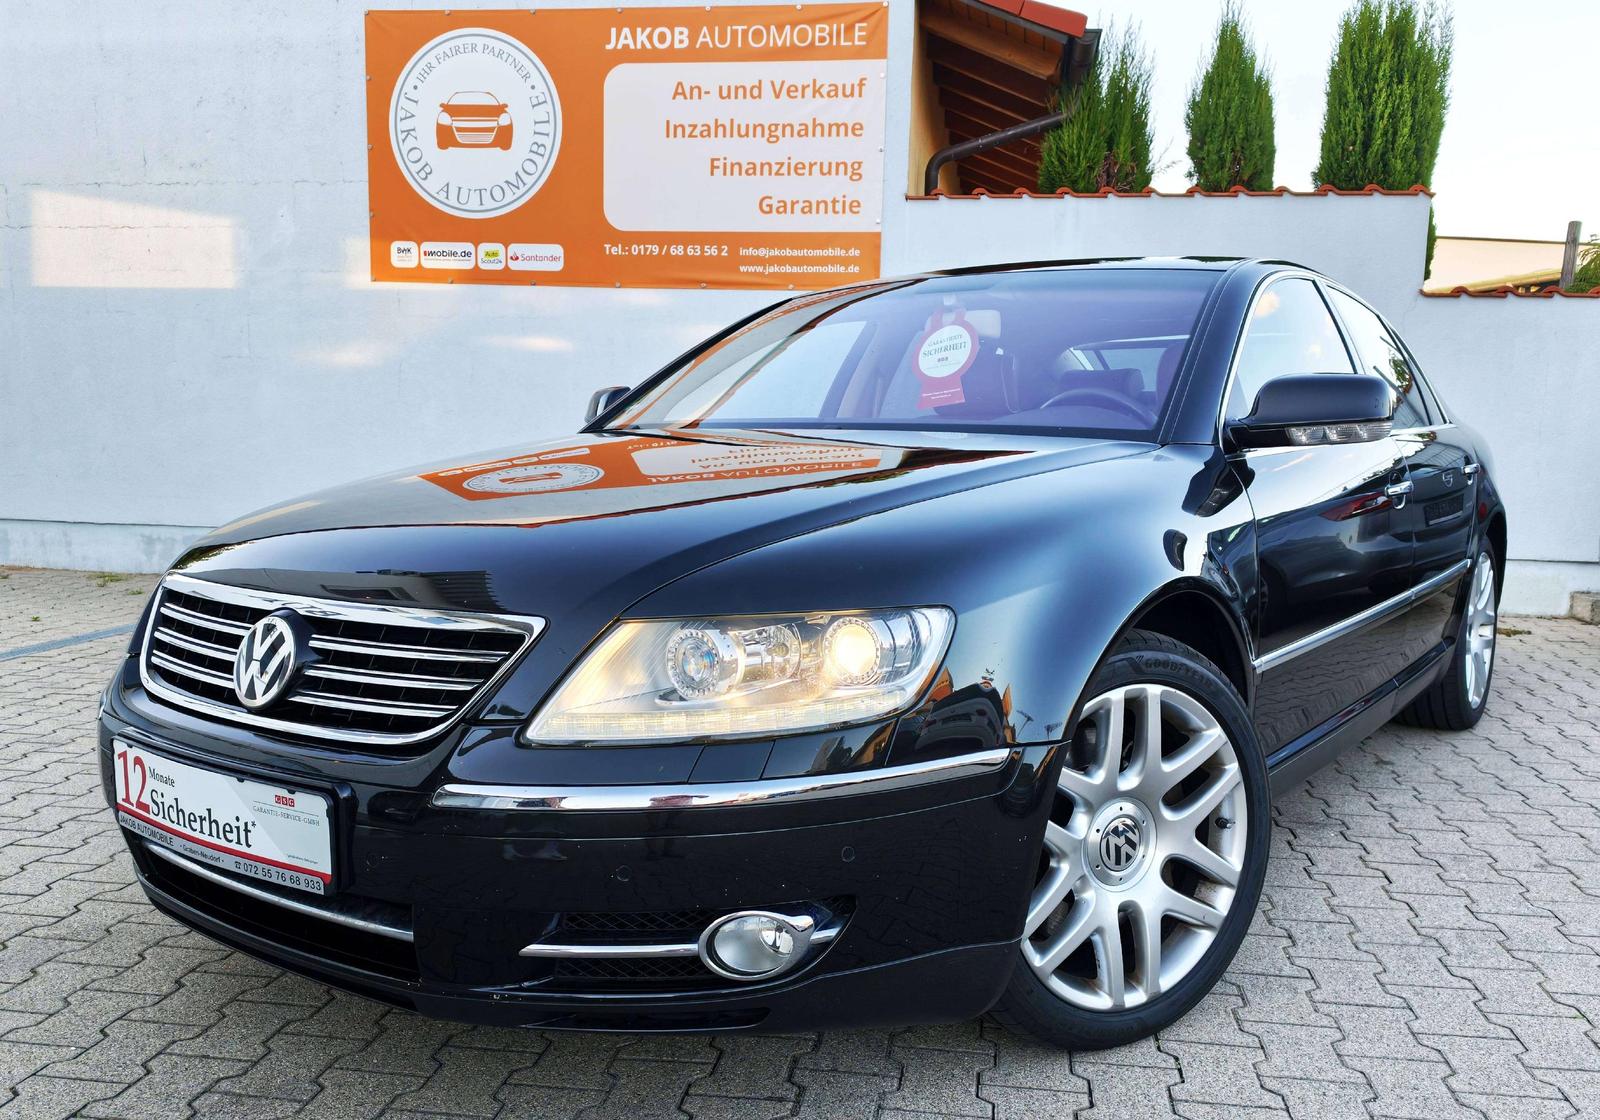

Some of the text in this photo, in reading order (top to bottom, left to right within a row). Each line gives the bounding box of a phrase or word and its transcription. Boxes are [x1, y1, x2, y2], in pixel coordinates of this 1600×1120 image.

[605, 23, 868, 49] JAKOB AUTOMOBILE
[416, 42, 531, 84] IHR FAIRER PARTNER
[672, 77, 867, 100] An- und Verkauf
[665, 118, 864, 144] Inzahlungnahme
[399, 91, 551, 206] JAKOB AUTOMOBILE
[710, 157, 864, 182] Finanzierung
[758, 195, 861, 216] Garantie
[520, 253, 562, 263] Santander
[603, 243, 629, 256] Tel.:
[631, 244, 659, 256] 0179
[669, 244, 684, 256] 68
[687, 244, 701, 256] 63
[704, 245, 718, 256] 56
[720, 245, 729, 256] 2
[739, 247, 861, 258] info@jakobautomobile.de
[739, 264, 860, 274] www.jakobautomobile.de
[922, 341, 967, 358] SICHERHEIT
[117, 750, 150, 815] 12
[148, 766, 175, 787] Monate
[120, 814, 136, 830] JAKOB
[136, 822, 175, 846] AUTOMOBILE
[243, 862, 259, 875] 072
[261, 867, 273, 878] 55
[275, 870, 287, 882] 76
[289, 874, 301, 885] 68
[304, 878, 322, 891] 933
